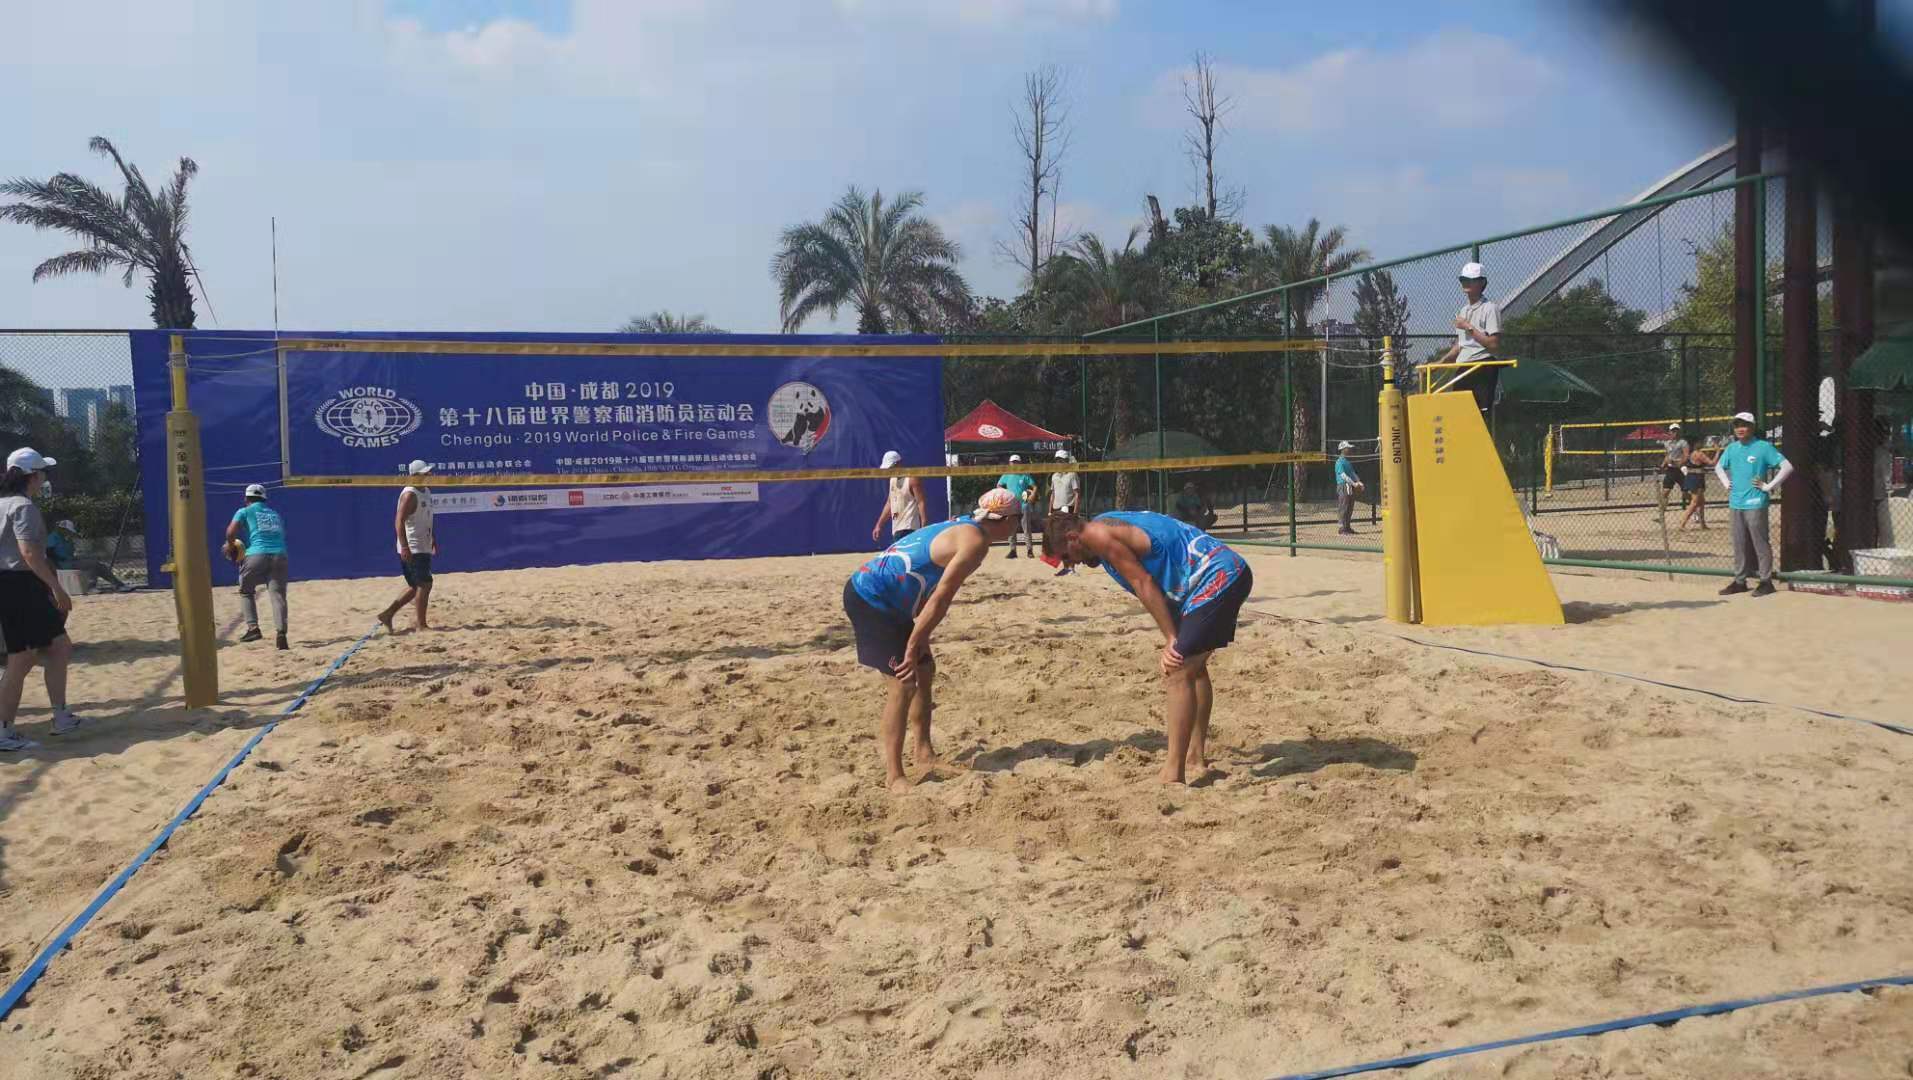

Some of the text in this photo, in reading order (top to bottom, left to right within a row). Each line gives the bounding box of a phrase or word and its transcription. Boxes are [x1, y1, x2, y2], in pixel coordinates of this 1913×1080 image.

[339, 386, 396, 400] WORLD
[353, 401, 384, 415] POLICE
[439, 403, 755, 427] 第十八届世界警察和消防员运动会
[358, 424, 380, 434] FIRE
[342, 434, 400, 448] GAMES
[440, 432, 512, 448] Chengdu
[524, 431, 562, 444] 2019
[565, 430, 608, 444] World
[612, 428, 659, 442] Police
[661, 429, 672, 441] &
[674, 428, 704, 441] Fire
[706, 427, 756, 440] Games
[1391, 426, 1402, 464] JINLING
